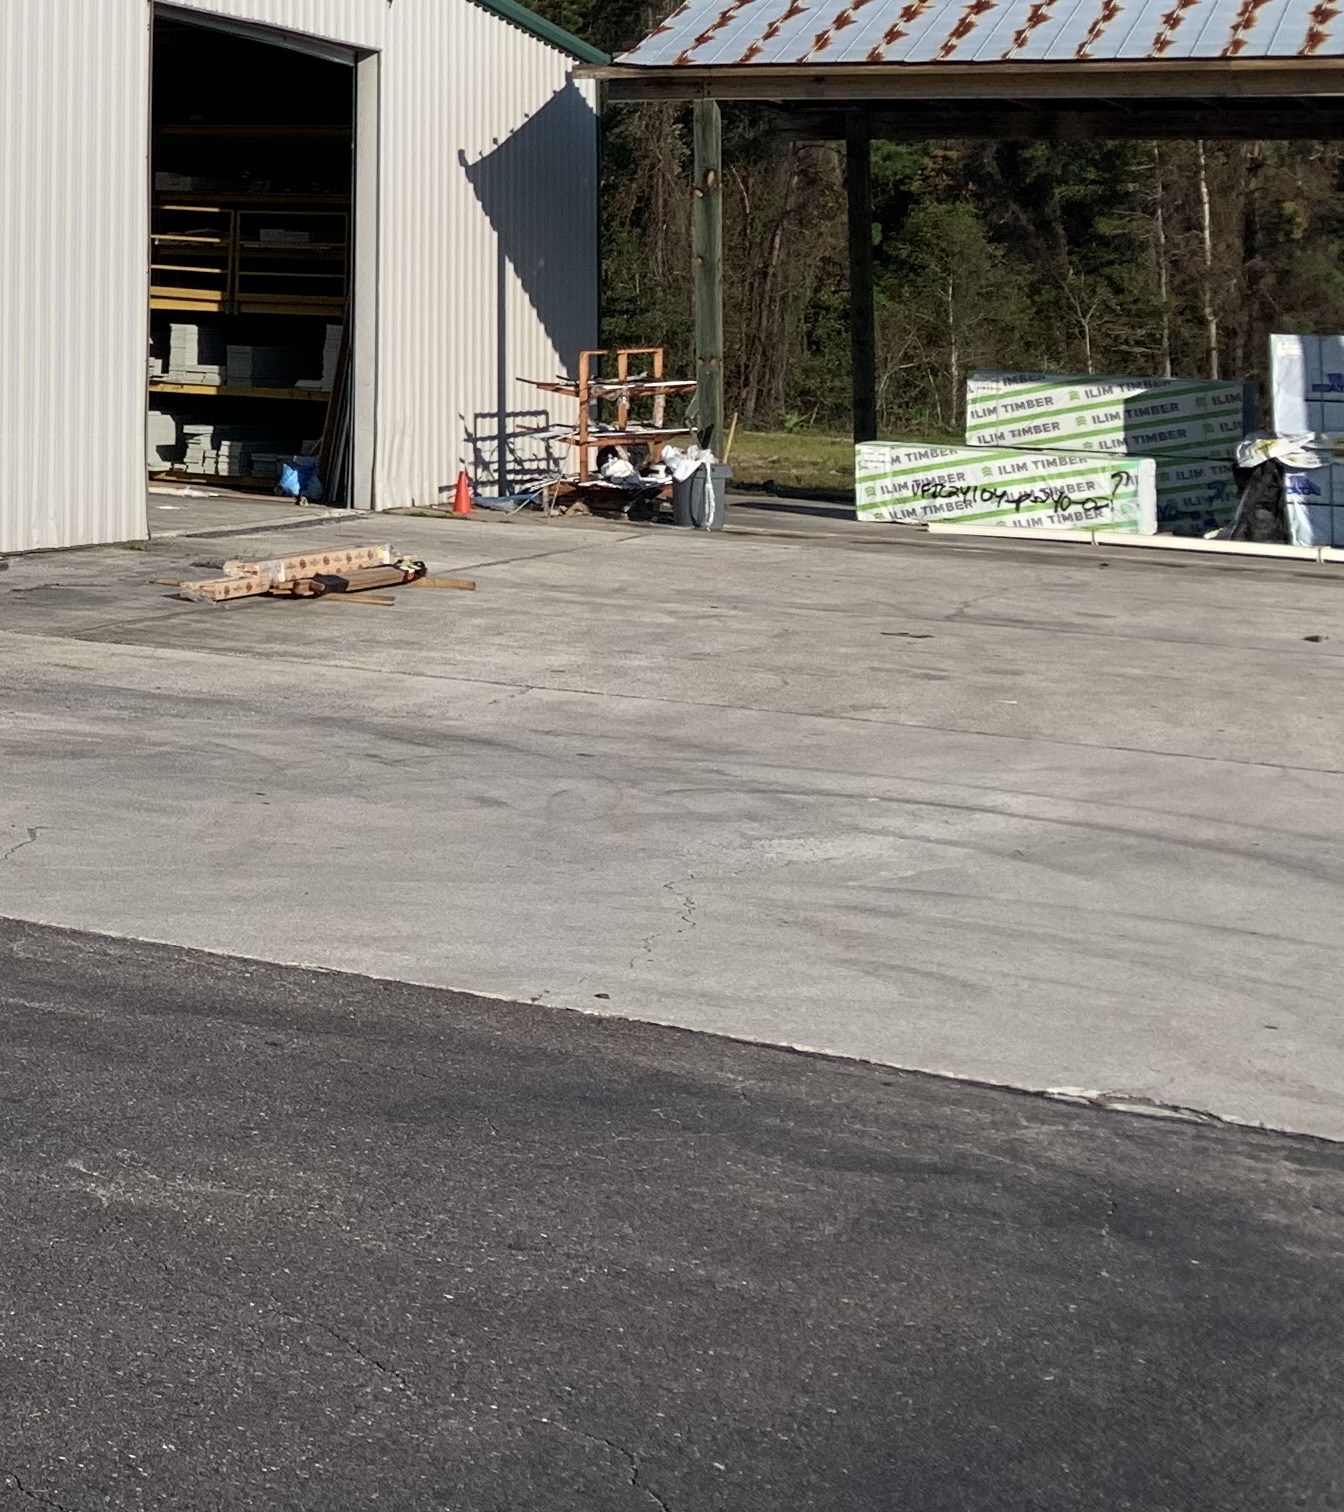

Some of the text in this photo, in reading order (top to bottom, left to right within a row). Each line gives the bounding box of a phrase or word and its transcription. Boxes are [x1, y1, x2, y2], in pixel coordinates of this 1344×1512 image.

[970, 395, 1055, 420] ILIM TIMBER
[1091, 401, 1180, 425] ILIM TIMBER
[976, 420, 1061, 445] ILIM TIMBER
[1098, 428, 1187, 450] ILIM TIMBER
[997, 461, 1029, 476] ILIM
[880, 481, 910, 496] ILIM
[919, 497, 975, 516] TIMBER
[1046, 508, 1104, 525] TIMBER
